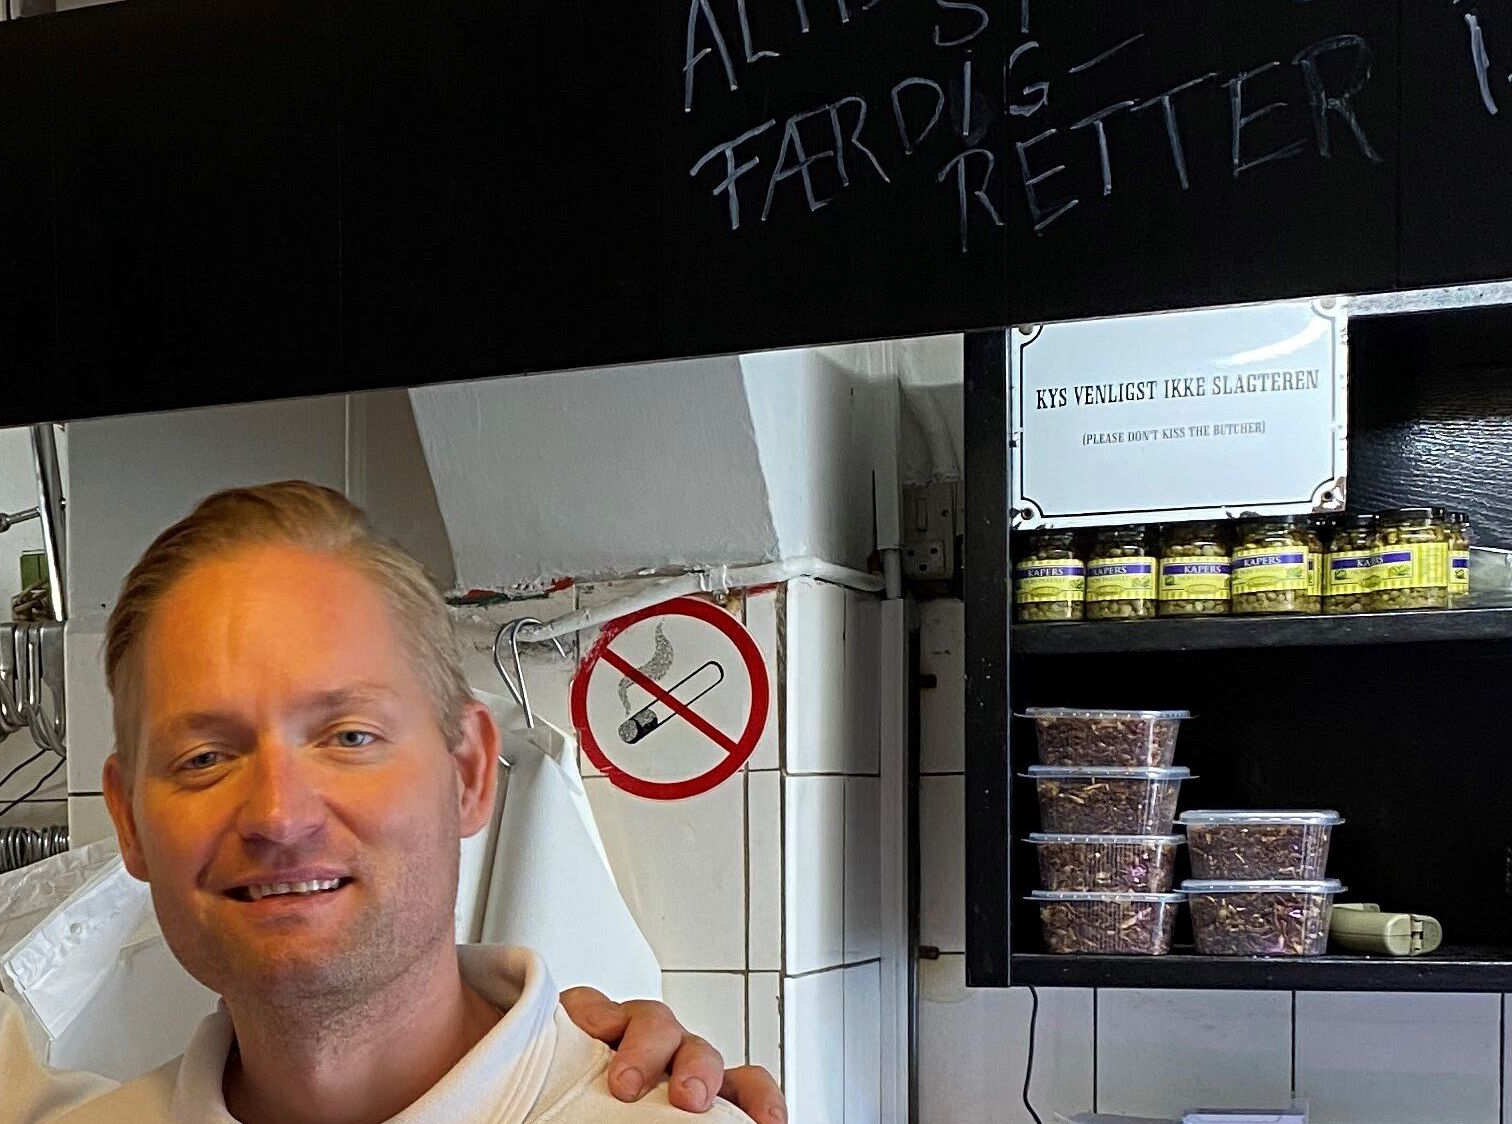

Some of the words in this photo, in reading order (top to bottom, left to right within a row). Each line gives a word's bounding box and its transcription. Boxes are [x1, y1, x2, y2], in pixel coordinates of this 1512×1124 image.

[937, 35, 1384, 253] RETTER
[1036, 388, 1068, 410] KYS
[1073, 380, 1157, 406] VENLIGST
[1163, 376, 1206, 399] IKKE
[1211, 369, 1320, 397] SLAGTEREN
[1127, 429, 1159, 442] DON'T
[1162, 427, 1186, 440] KISS
[1187, 424, 1211, 438] THE
[1243, 556, 1282, 567] KAPERS
[1027, 567, 1065, 578] KAPERS
[1183, 564, 1222, 575] KAPERS
